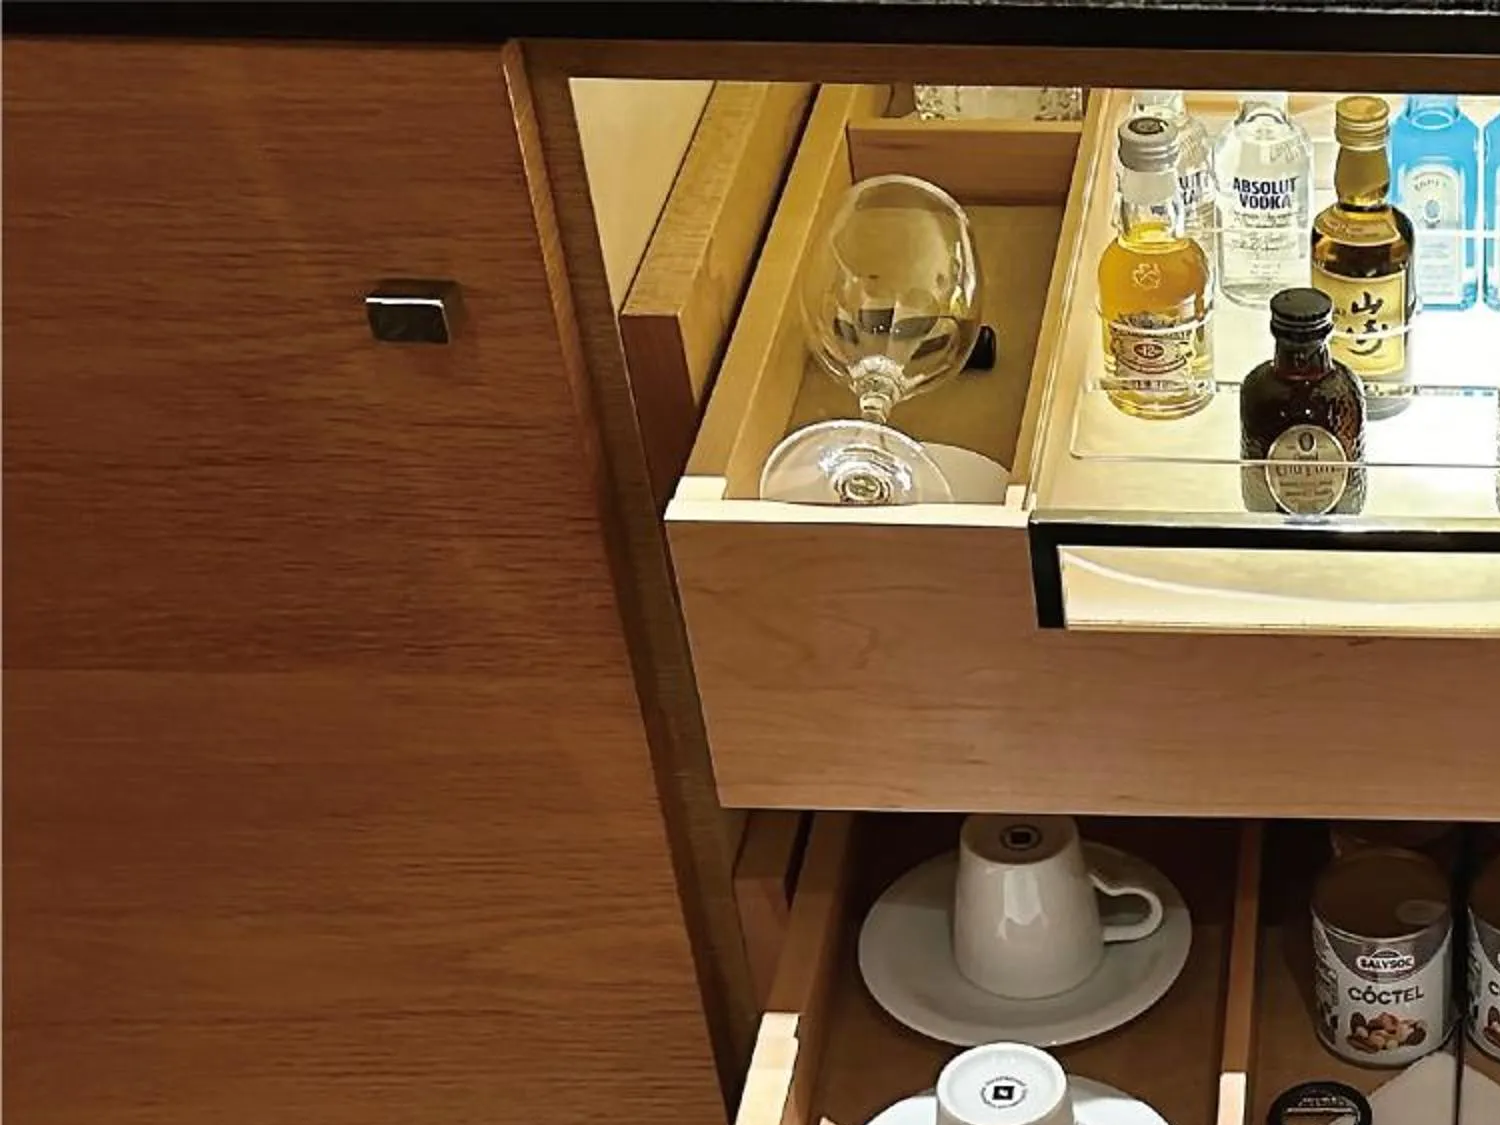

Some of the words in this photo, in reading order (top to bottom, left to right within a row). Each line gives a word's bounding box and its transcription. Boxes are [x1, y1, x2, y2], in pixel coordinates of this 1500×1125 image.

[1232, 176, 1299, 194] ABSOLUT
[1239, 194, 1292, 210] VODKA
[1347, 984, 1424, 1005] CÓCTEL
